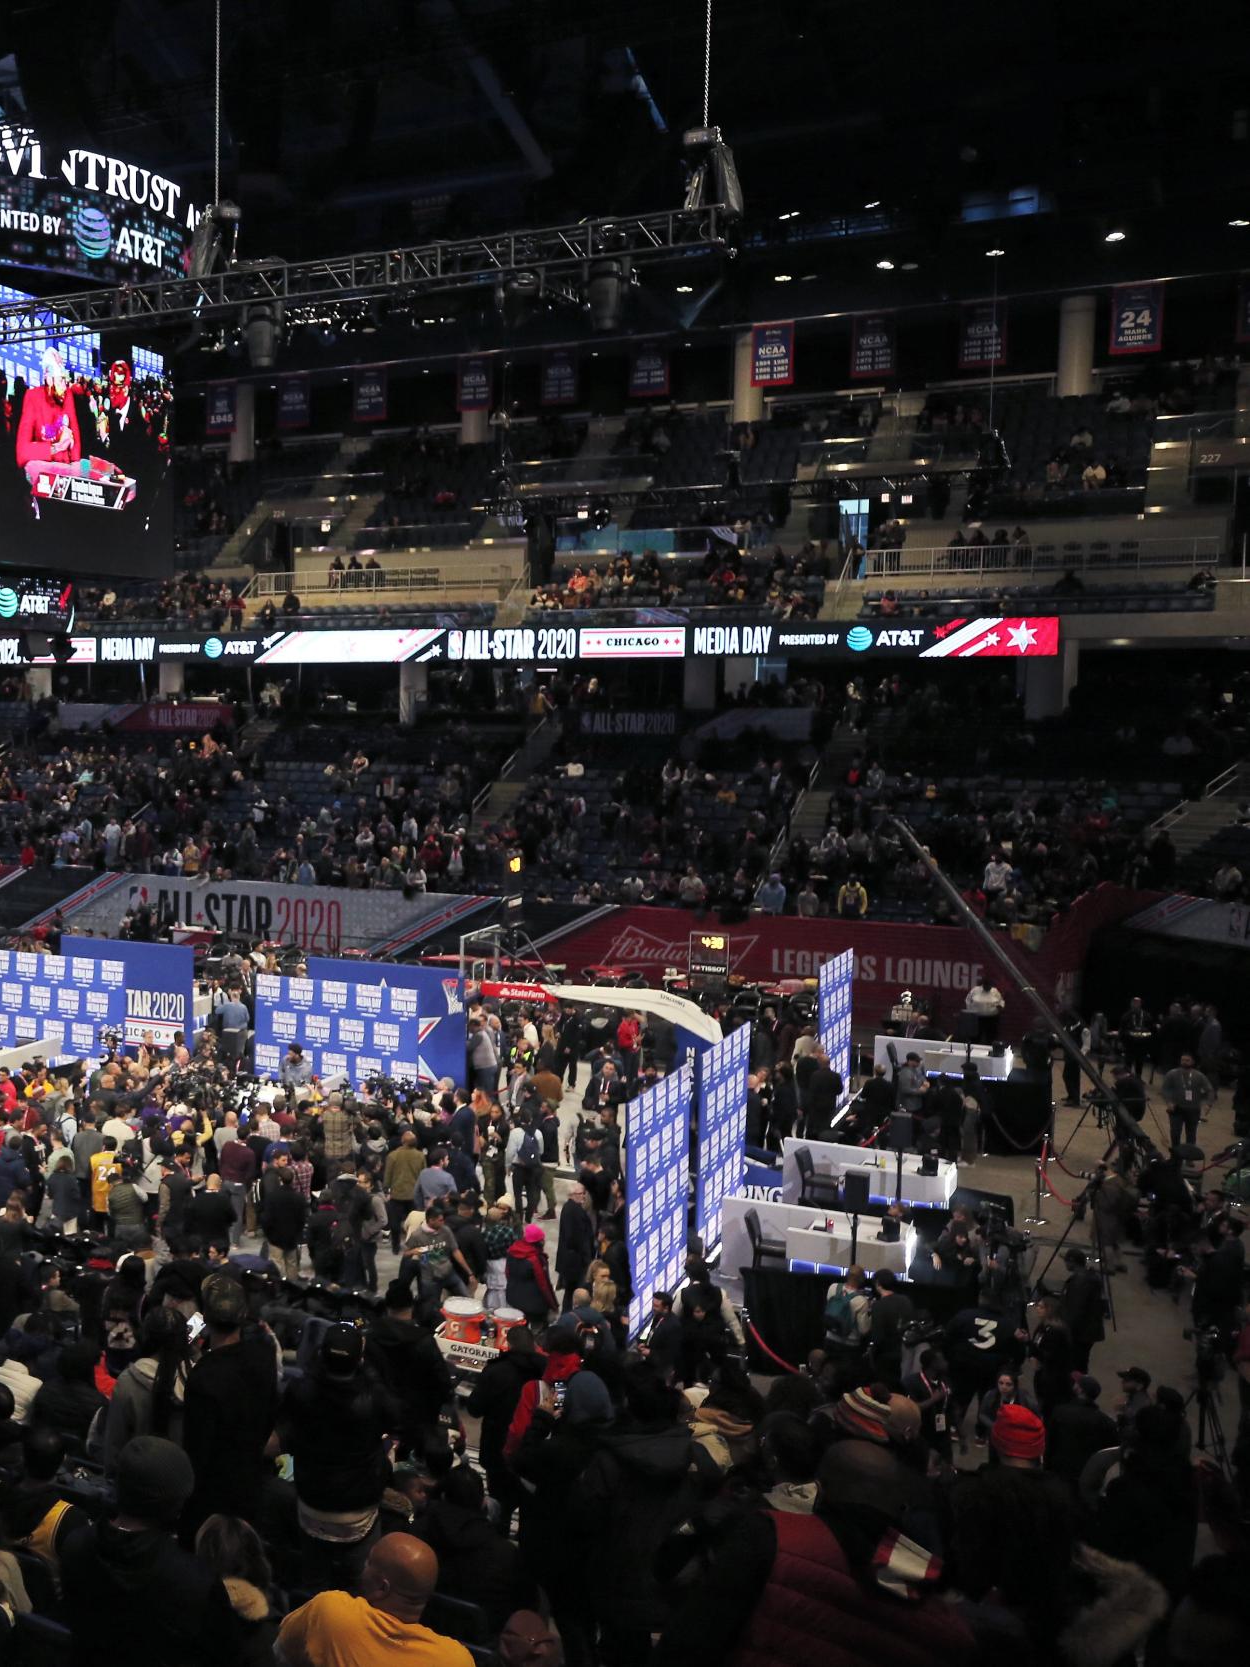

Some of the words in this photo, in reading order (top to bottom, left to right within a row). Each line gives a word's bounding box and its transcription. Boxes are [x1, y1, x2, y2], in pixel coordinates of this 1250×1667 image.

[43, 216, 62, 236] BY
[116, 227, 166, 268] AT&T
[1120, 309, 1152, 328] 24
[758, 345, 787, 356] NCAA
[1200, 453, 1222, 464] 227
[20, 595, 50, 614] AT&T
[101, 637, 133, 661] MEDIA
[134, 637, 155, 660] DAY
[223, 640, 257, 655] AT&T
[538, 628, 576, 660] 2020
[606, 637, 659, 647] CHICAGO
[693, 627, 739, 655] MEDIA
[742, 626, 772, 654] DAY
[779, 634, 826, 646] PRESENTED
[826, 633, 839, 645] BY
[876, 629, 924, 646] AT&T
[646, 711, 676, 735] 2020
[277, 896, 342, 950] 2020
[701, 965, 726, 974] TISSOT
[885, 956, 983, 990] LOUNGE
[152, 991, 185, 1022] 2020
